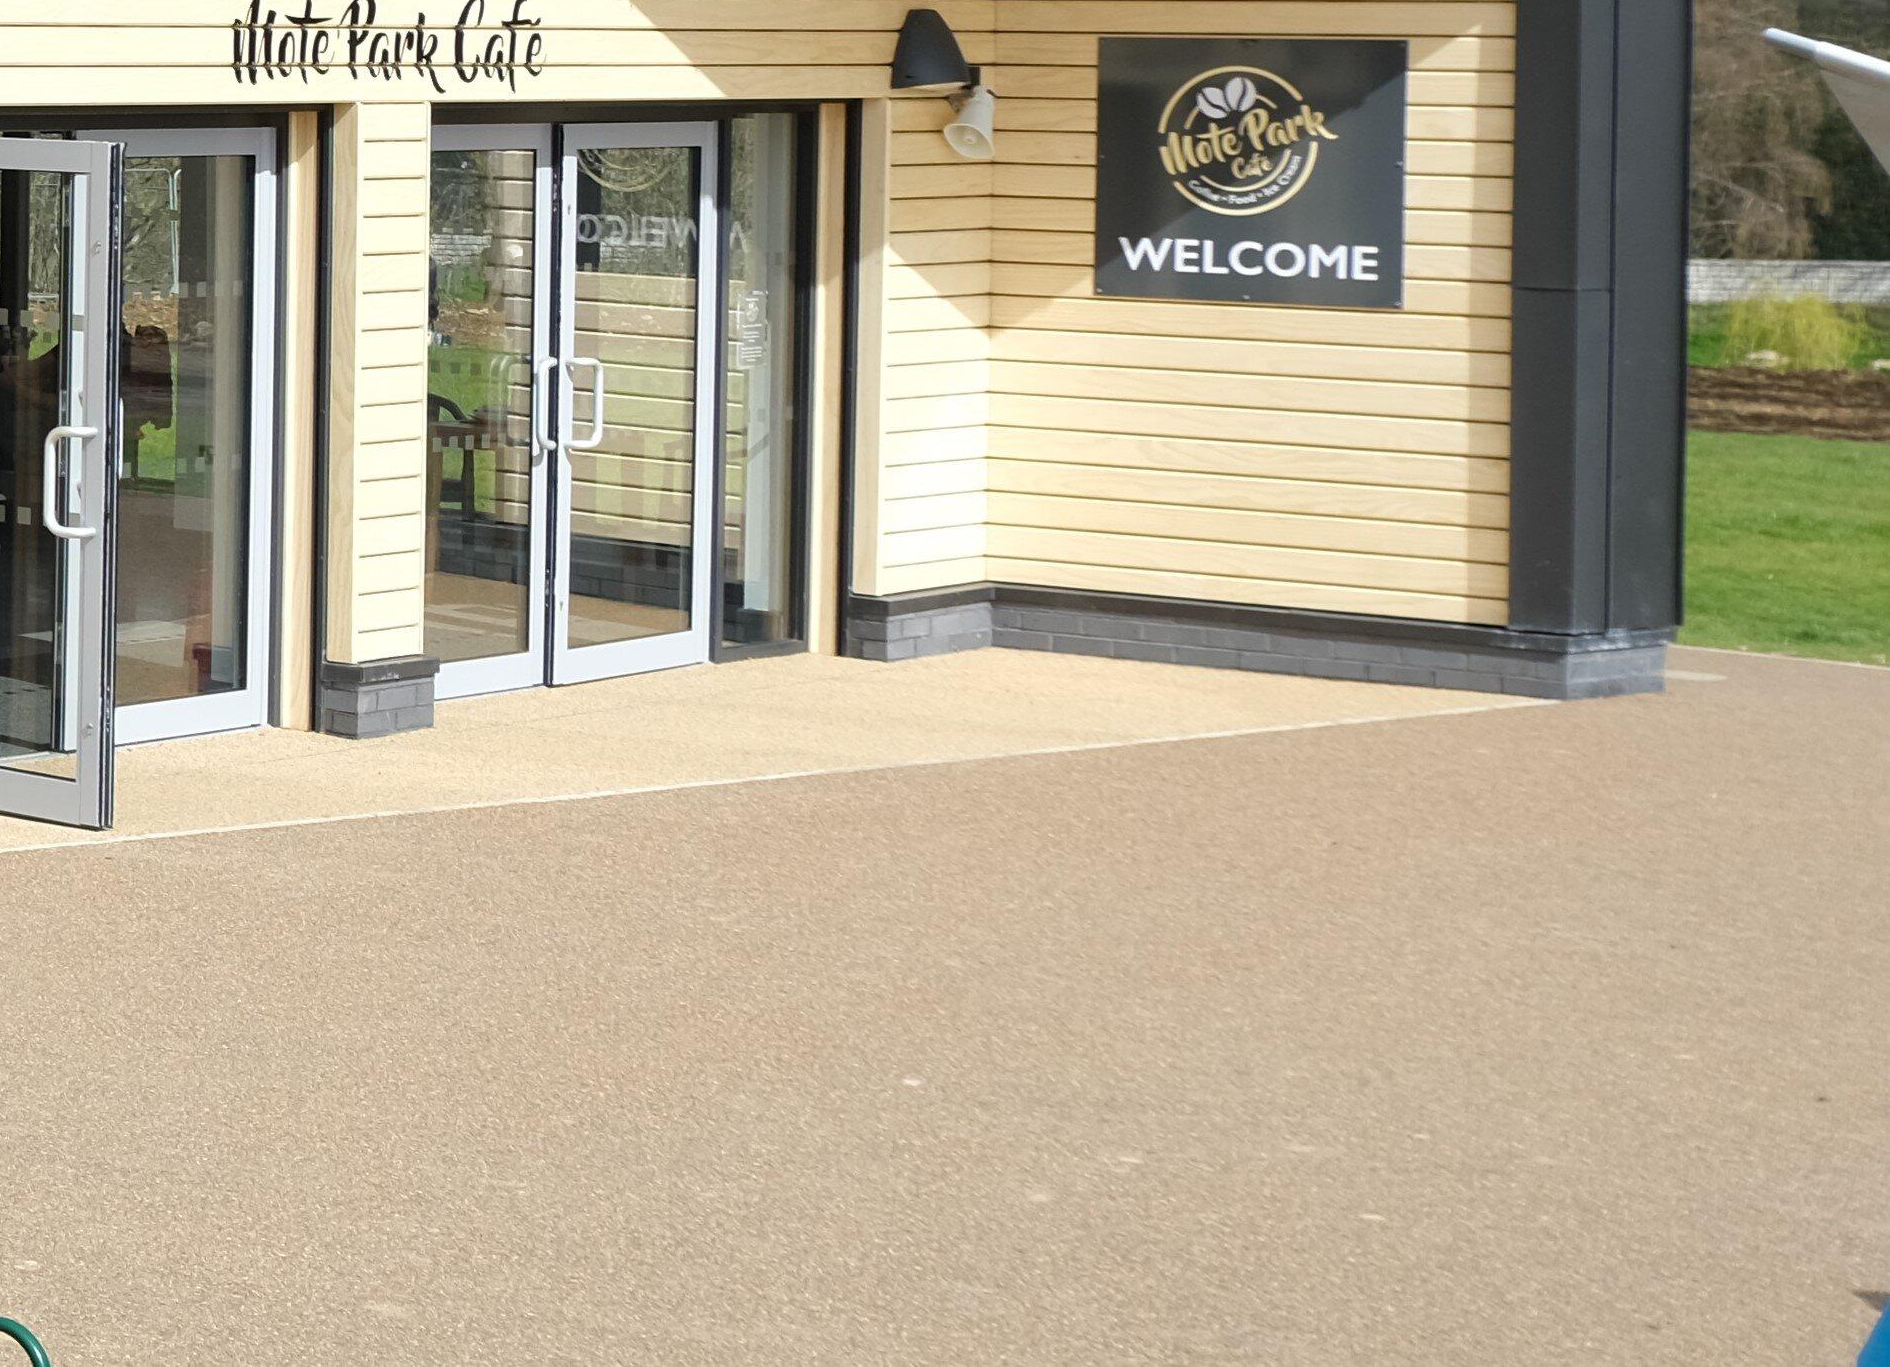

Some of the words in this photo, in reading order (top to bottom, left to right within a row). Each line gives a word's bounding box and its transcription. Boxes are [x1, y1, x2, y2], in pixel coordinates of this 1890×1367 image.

[1158, 122, 1243, 176] Mote
[1238, 103, 1340, 151] Park
[1118, 236, 1379, 282] WELCOME
